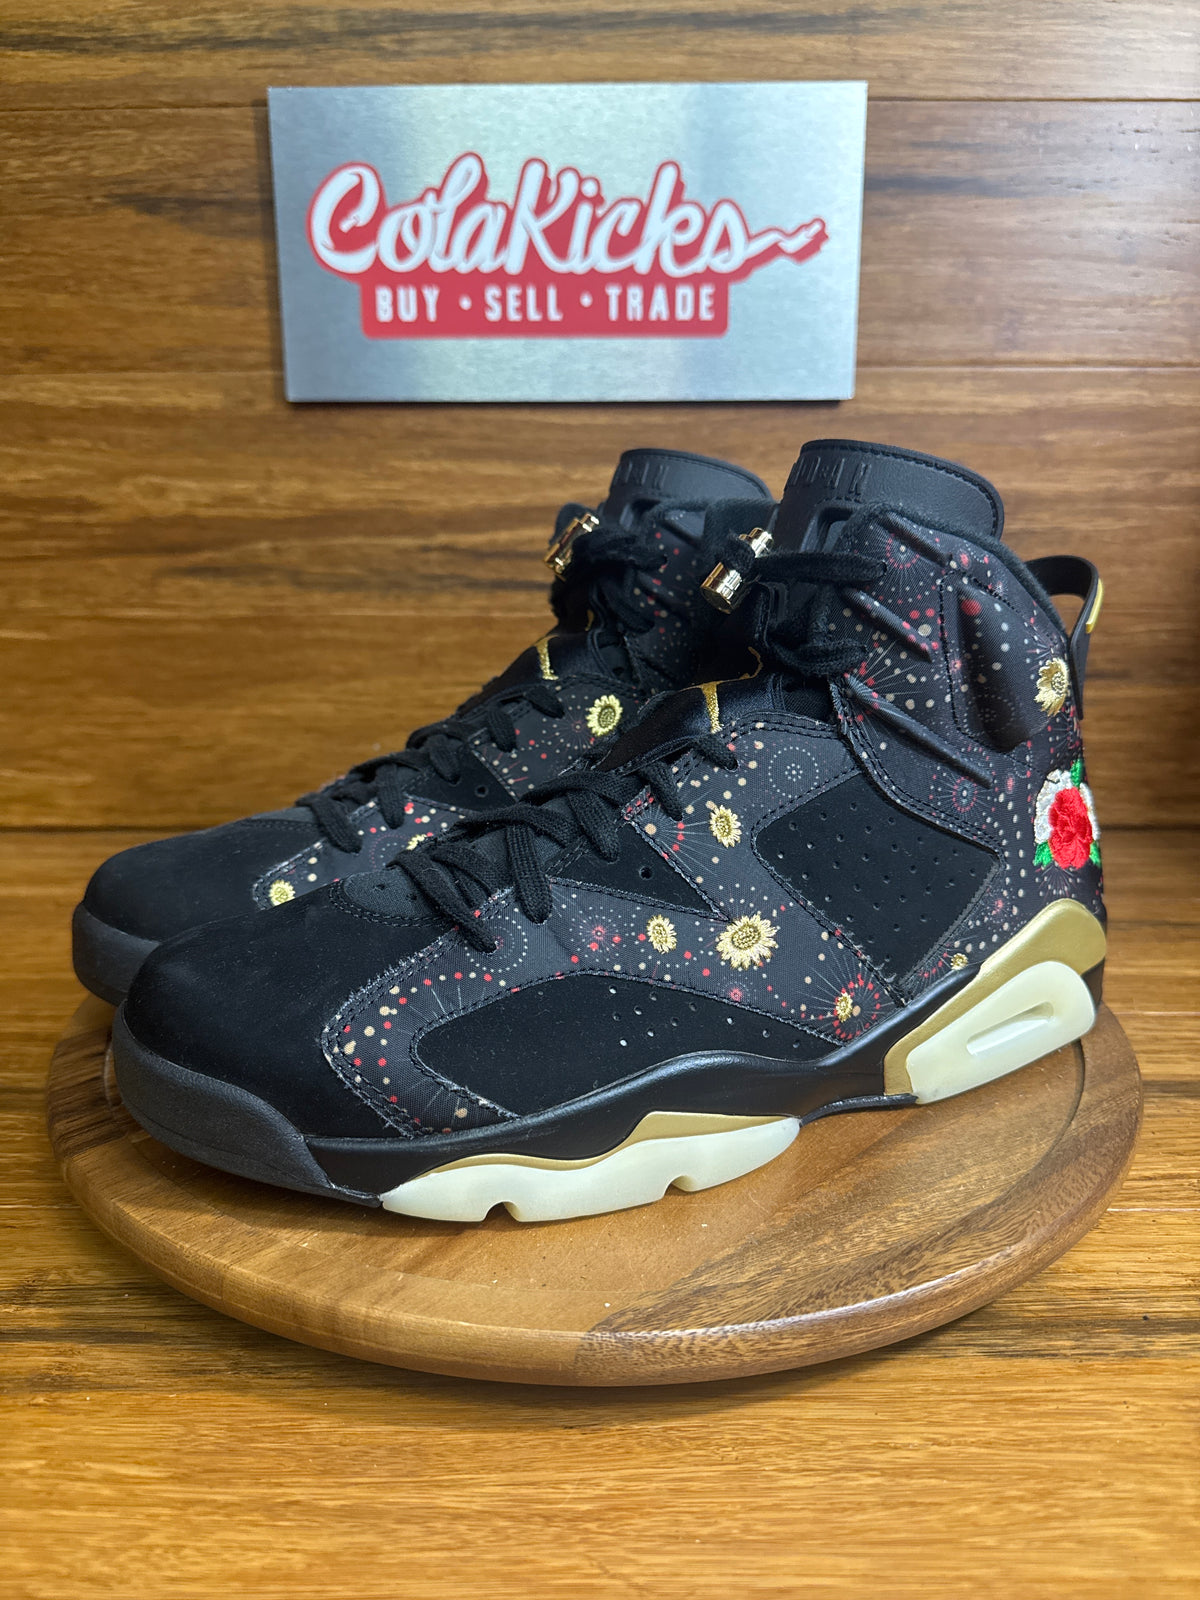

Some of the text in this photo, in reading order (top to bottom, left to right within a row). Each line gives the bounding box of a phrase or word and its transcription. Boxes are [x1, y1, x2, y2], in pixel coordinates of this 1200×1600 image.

[308, 152, 824, 276] ColaKicks
[376, 284, 715, 322] BUY SELL TRADE
